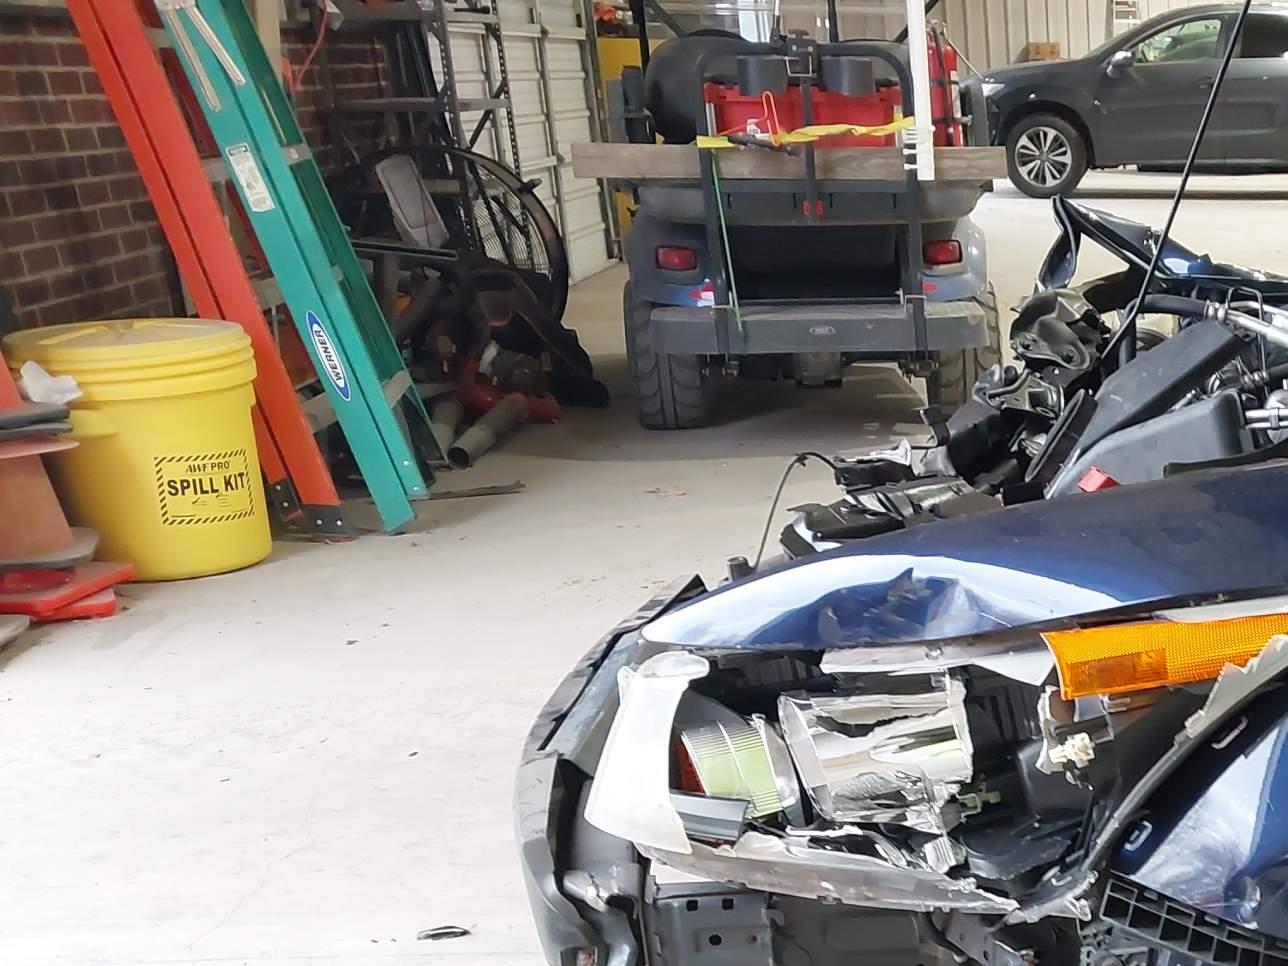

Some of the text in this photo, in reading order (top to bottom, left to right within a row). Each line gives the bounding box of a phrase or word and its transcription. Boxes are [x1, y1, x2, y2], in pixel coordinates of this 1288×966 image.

[313, 328, 343, 381] WERNER
[210, 460, 230, 471] PRO
[167, 471, 245, 497] SPILL KIT
